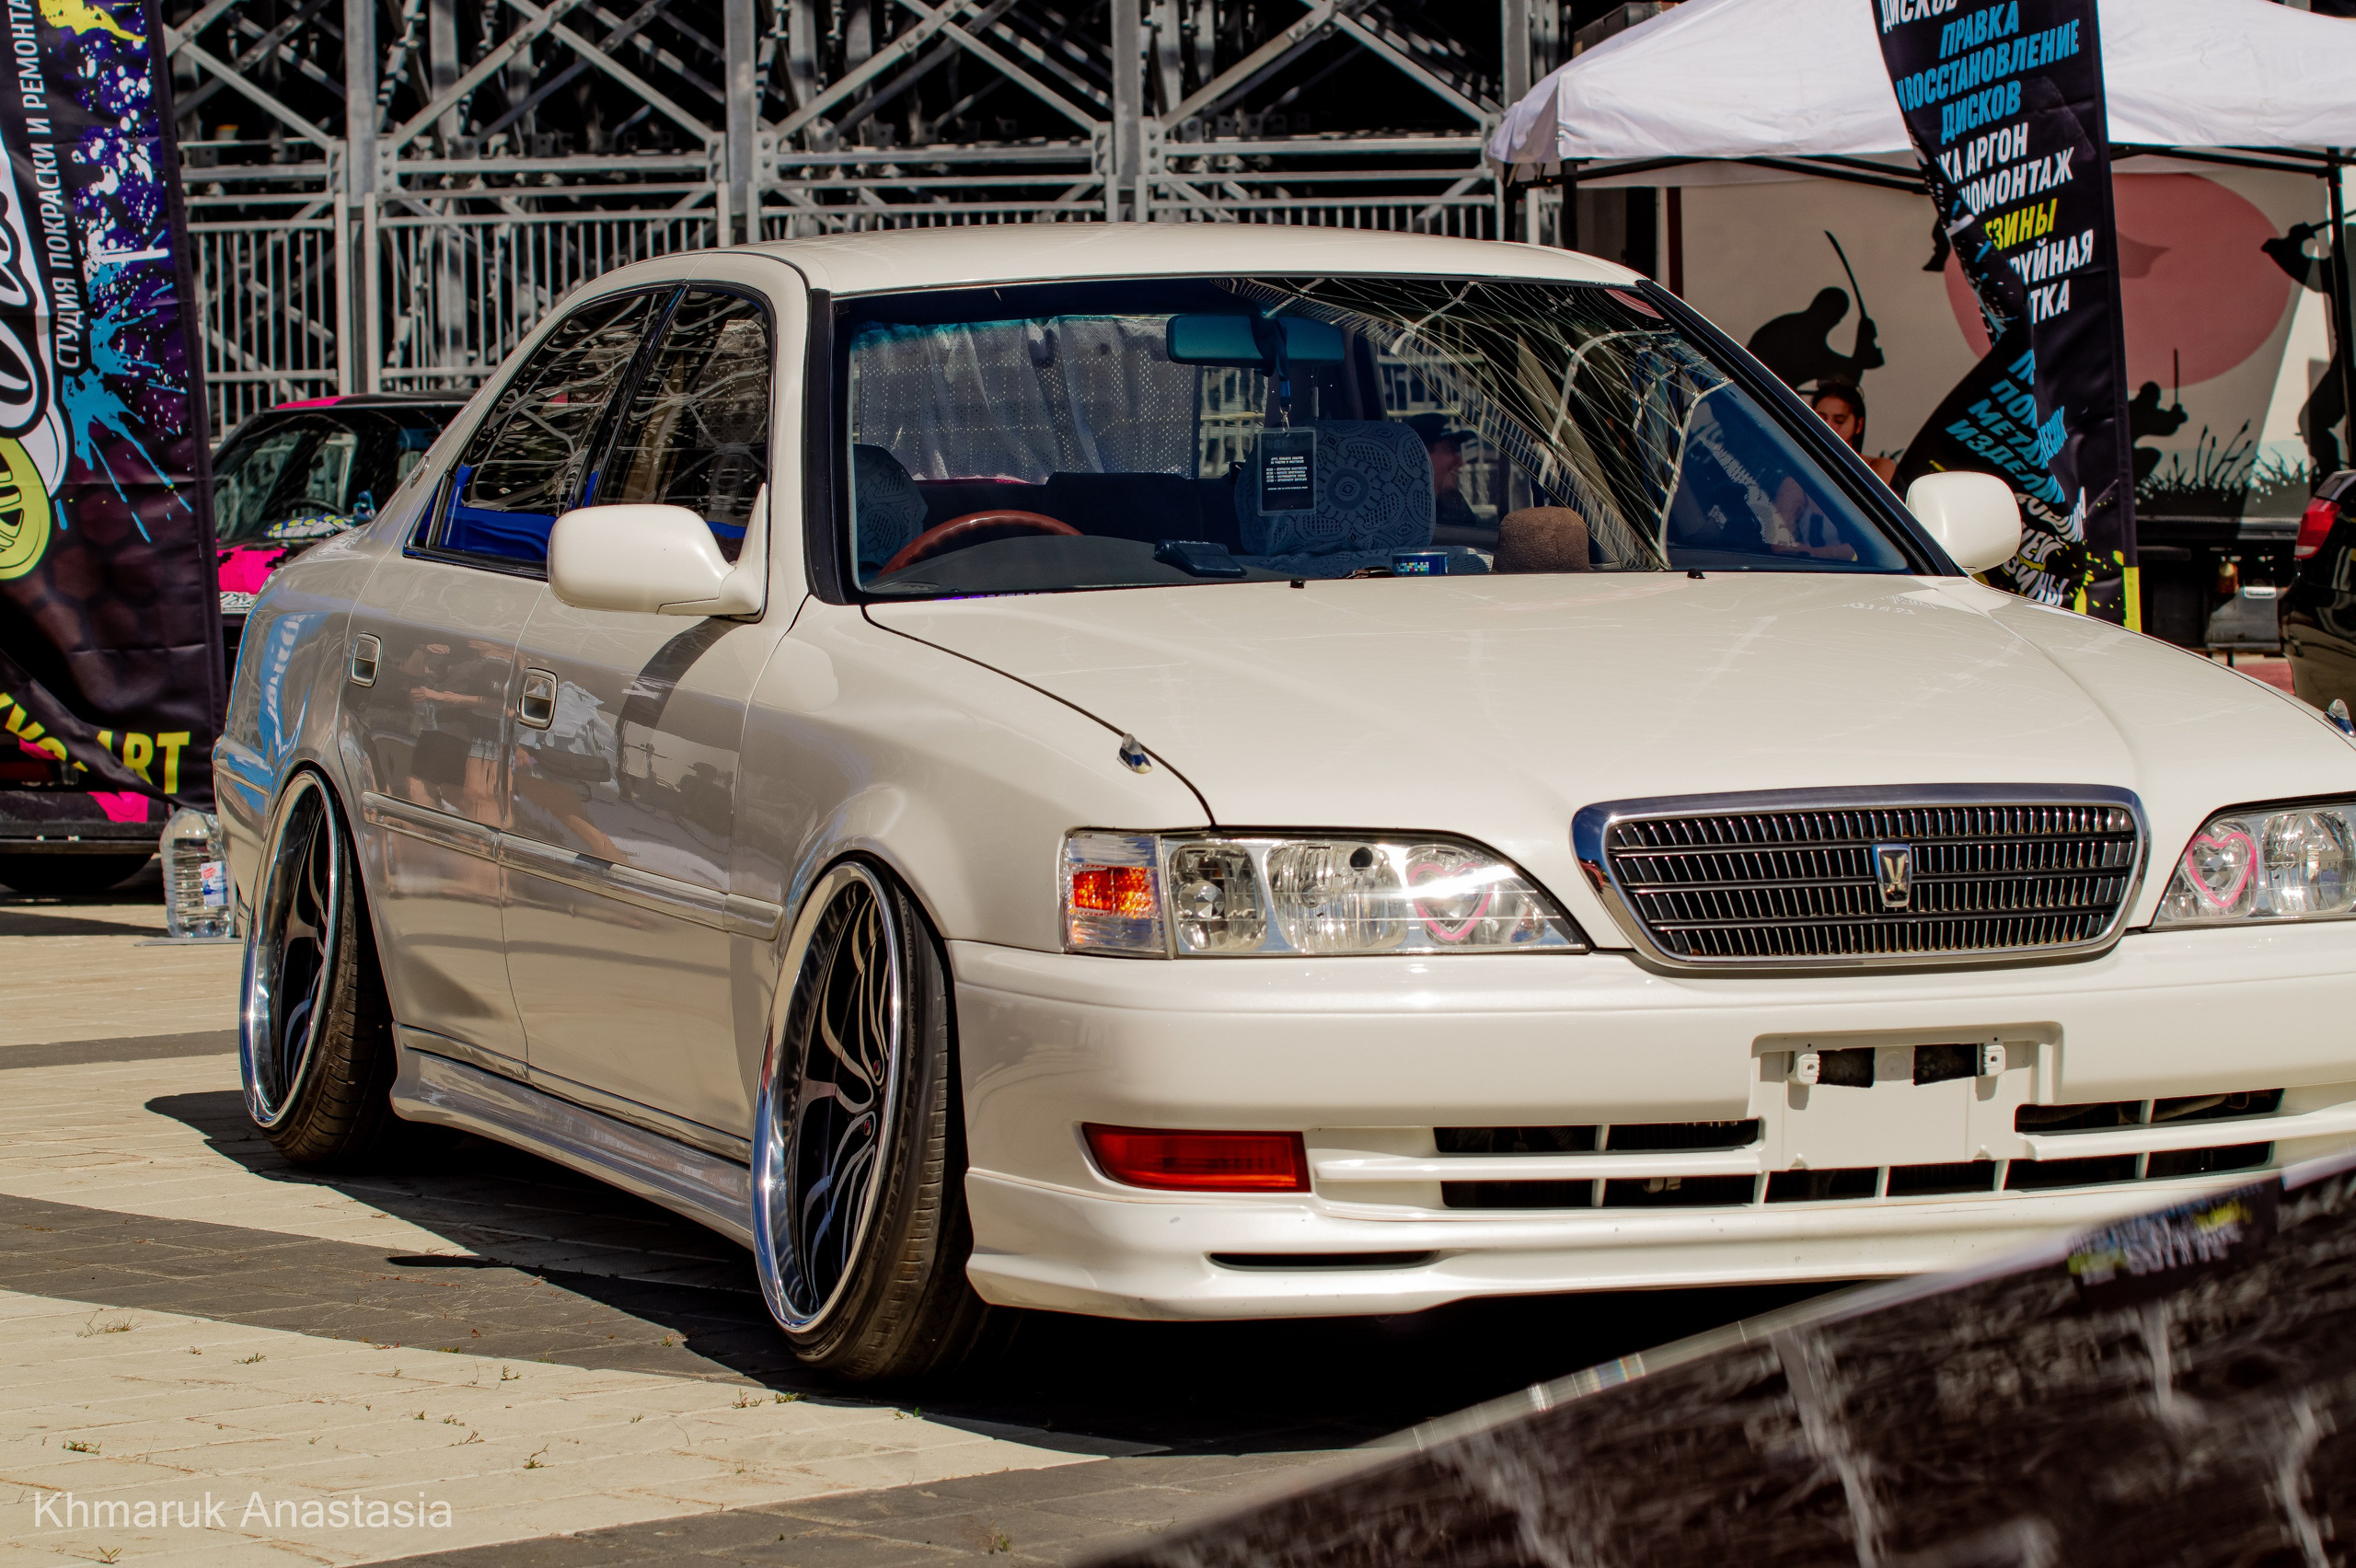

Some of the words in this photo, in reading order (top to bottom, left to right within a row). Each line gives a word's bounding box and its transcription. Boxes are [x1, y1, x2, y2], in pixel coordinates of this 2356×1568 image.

[1939, 1, 2019, 59] ПРАВКА
[1903, 18, 2079, 111] ВОССТАНОВЛЕНИЕ
[26, 117, 52, 134] И
[1940, 80, 2022, 145] ДИСКОВ
[1965, 122, 2029, 178] АРГОН
[30, 142, 77, 271] ПОКРАСКИ
[1958, 146, 2075, 216] НОМОНТАЖ
[54, 274, 85, 368] СТУДИЯ
[2028, 279, 2070, 325] ТКА
[2002, 553, 2070, 608] ЗИНЫ
